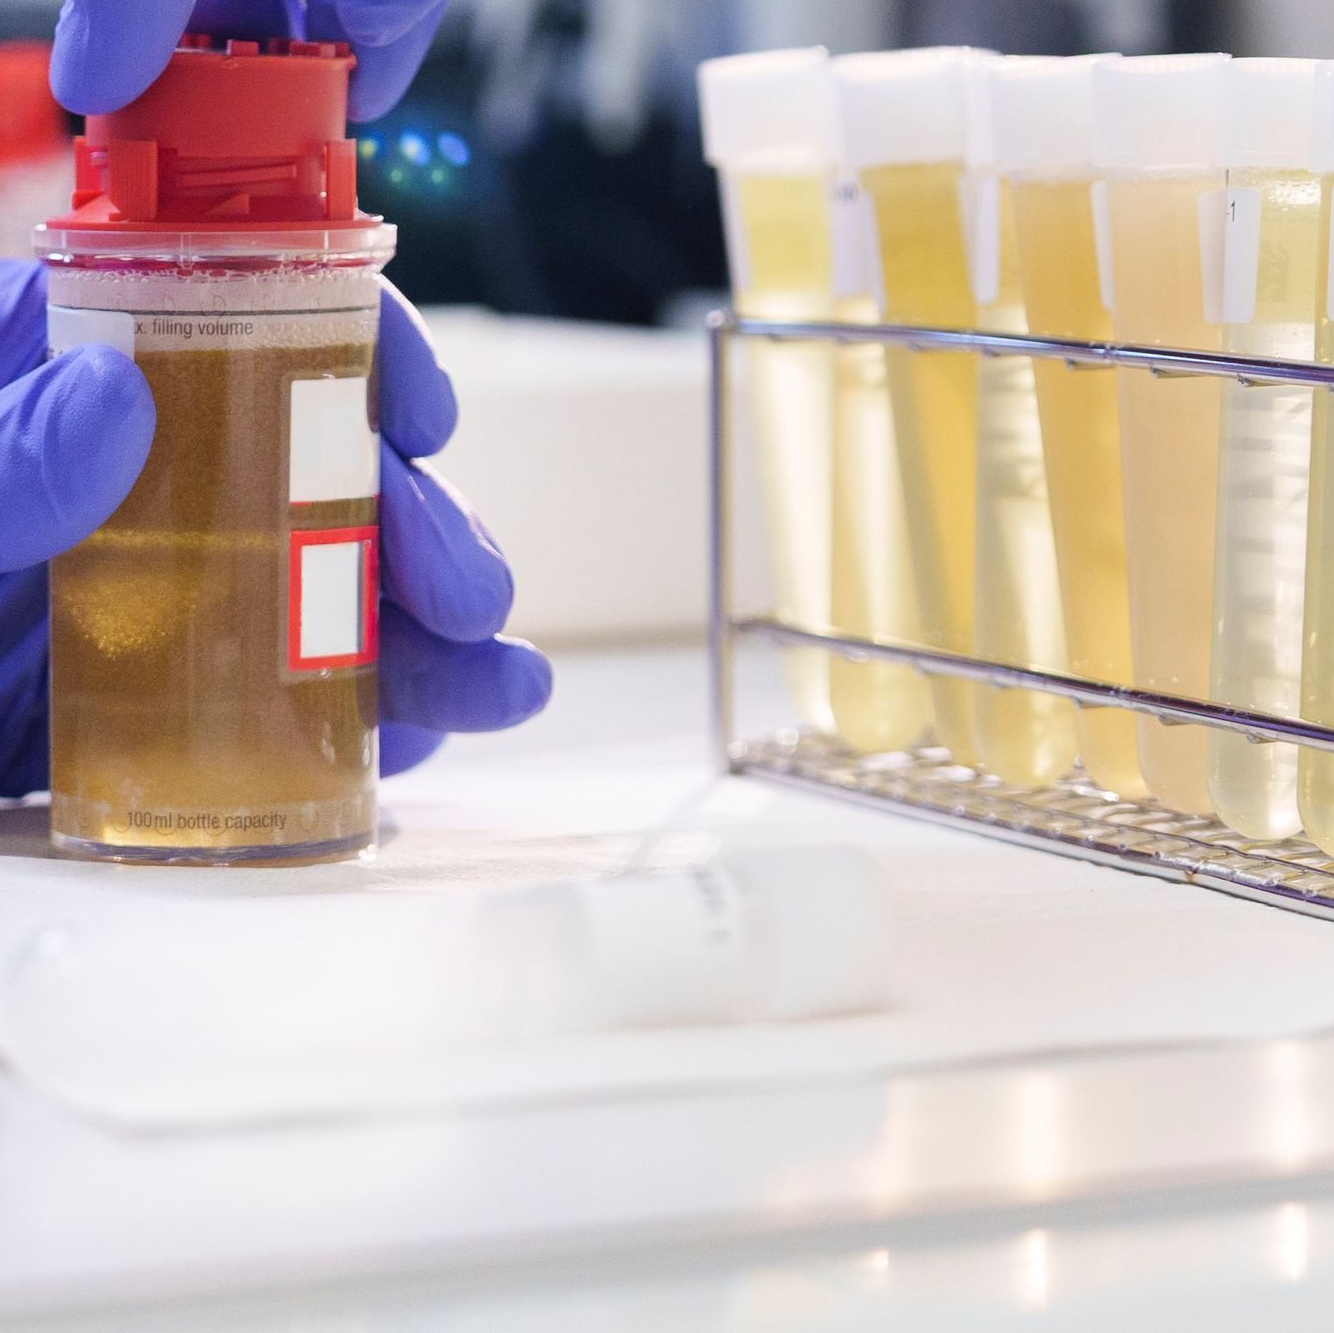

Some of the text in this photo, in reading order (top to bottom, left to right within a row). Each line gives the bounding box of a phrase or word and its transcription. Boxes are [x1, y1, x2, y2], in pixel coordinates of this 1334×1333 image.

[152, 318, 193, 339] filling
[197, 319, 254, 336] volume
[177, 813, 220, 829] bottle
[225, 811, 287, 831] capacity
